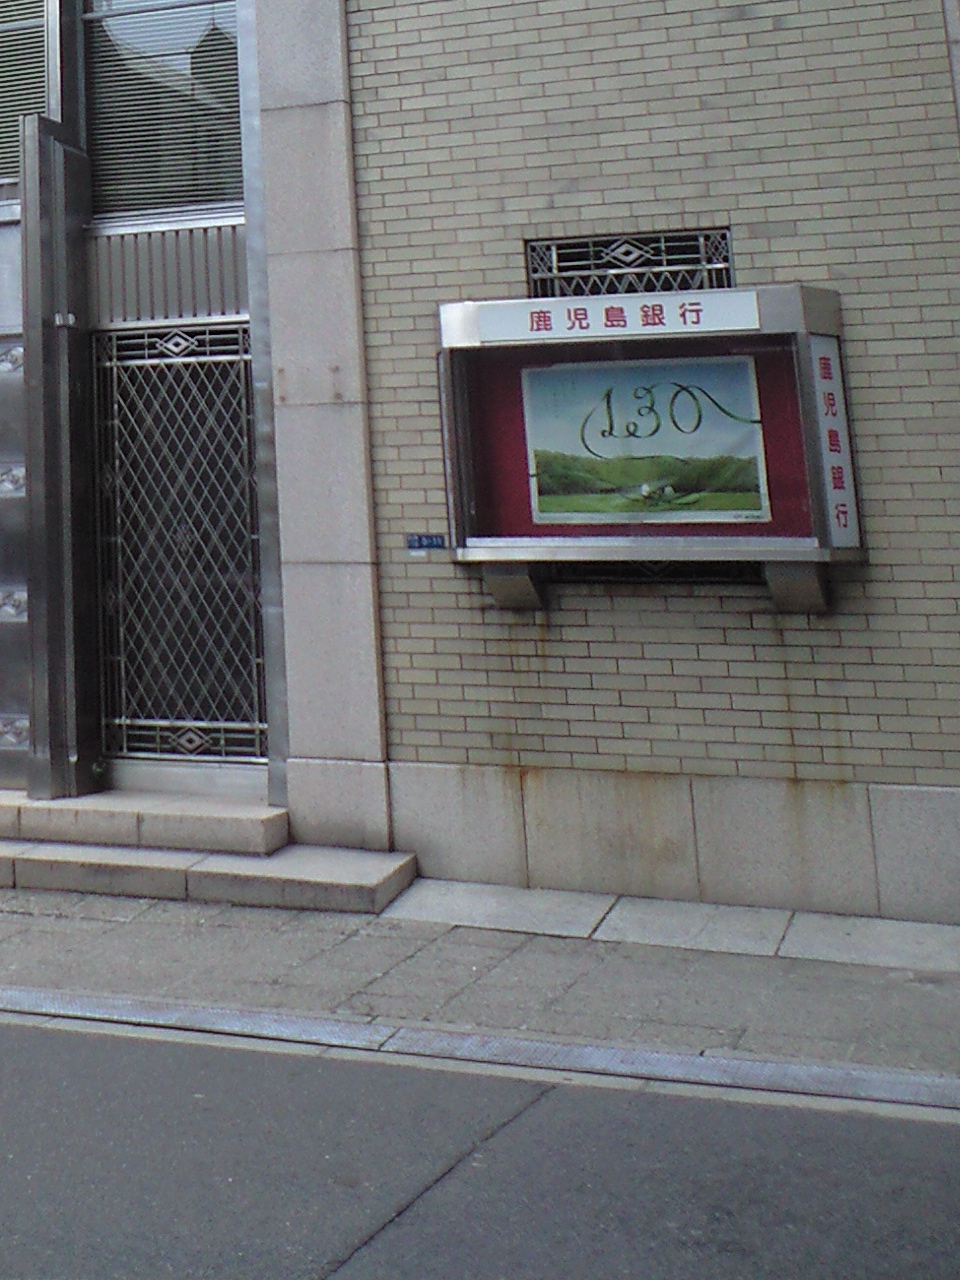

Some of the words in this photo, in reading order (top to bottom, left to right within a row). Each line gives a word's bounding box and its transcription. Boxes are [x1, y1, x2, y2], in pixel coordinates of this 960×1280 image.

[530, 302, 703, 332] 鹿児島銀行
[600, 381, 702, 438] 130
[818, 356, 848, 528] 鹿児島銀行
